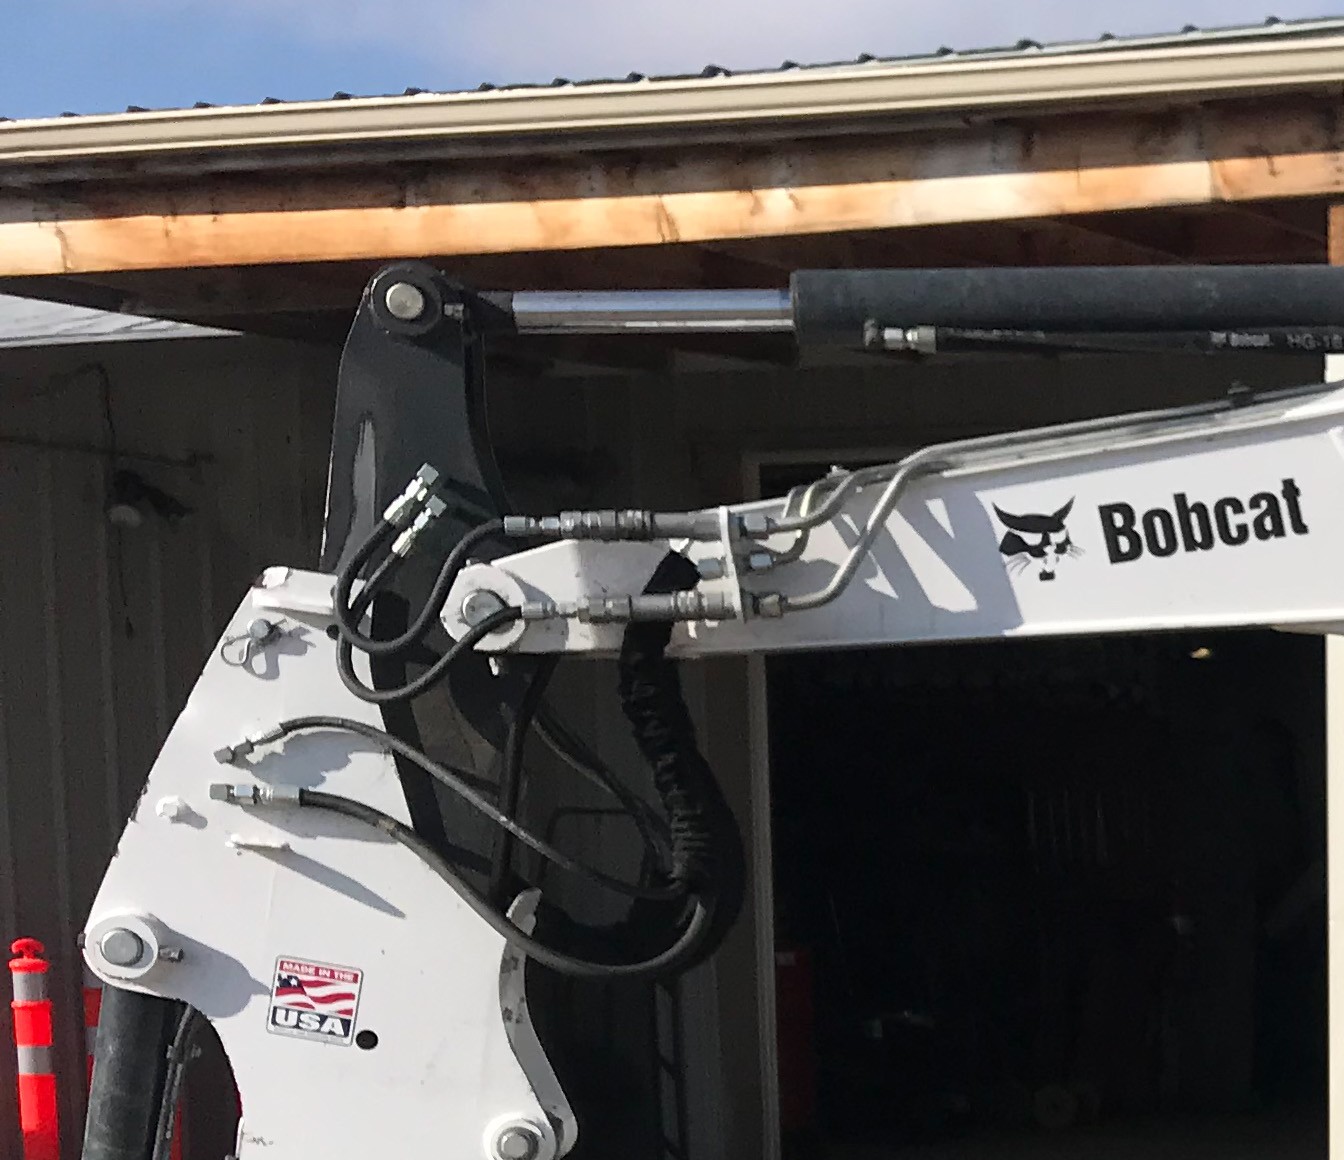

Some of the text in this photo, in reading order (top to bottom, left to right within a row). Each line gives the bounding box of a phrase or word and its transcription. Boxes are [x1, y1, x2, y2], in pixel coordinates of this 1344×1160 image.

[1098, 478, 1309, 564] Bobcat
[282, 961, 353, 982] MADE IN THE
[276, 1008, 345, 1036] USA
